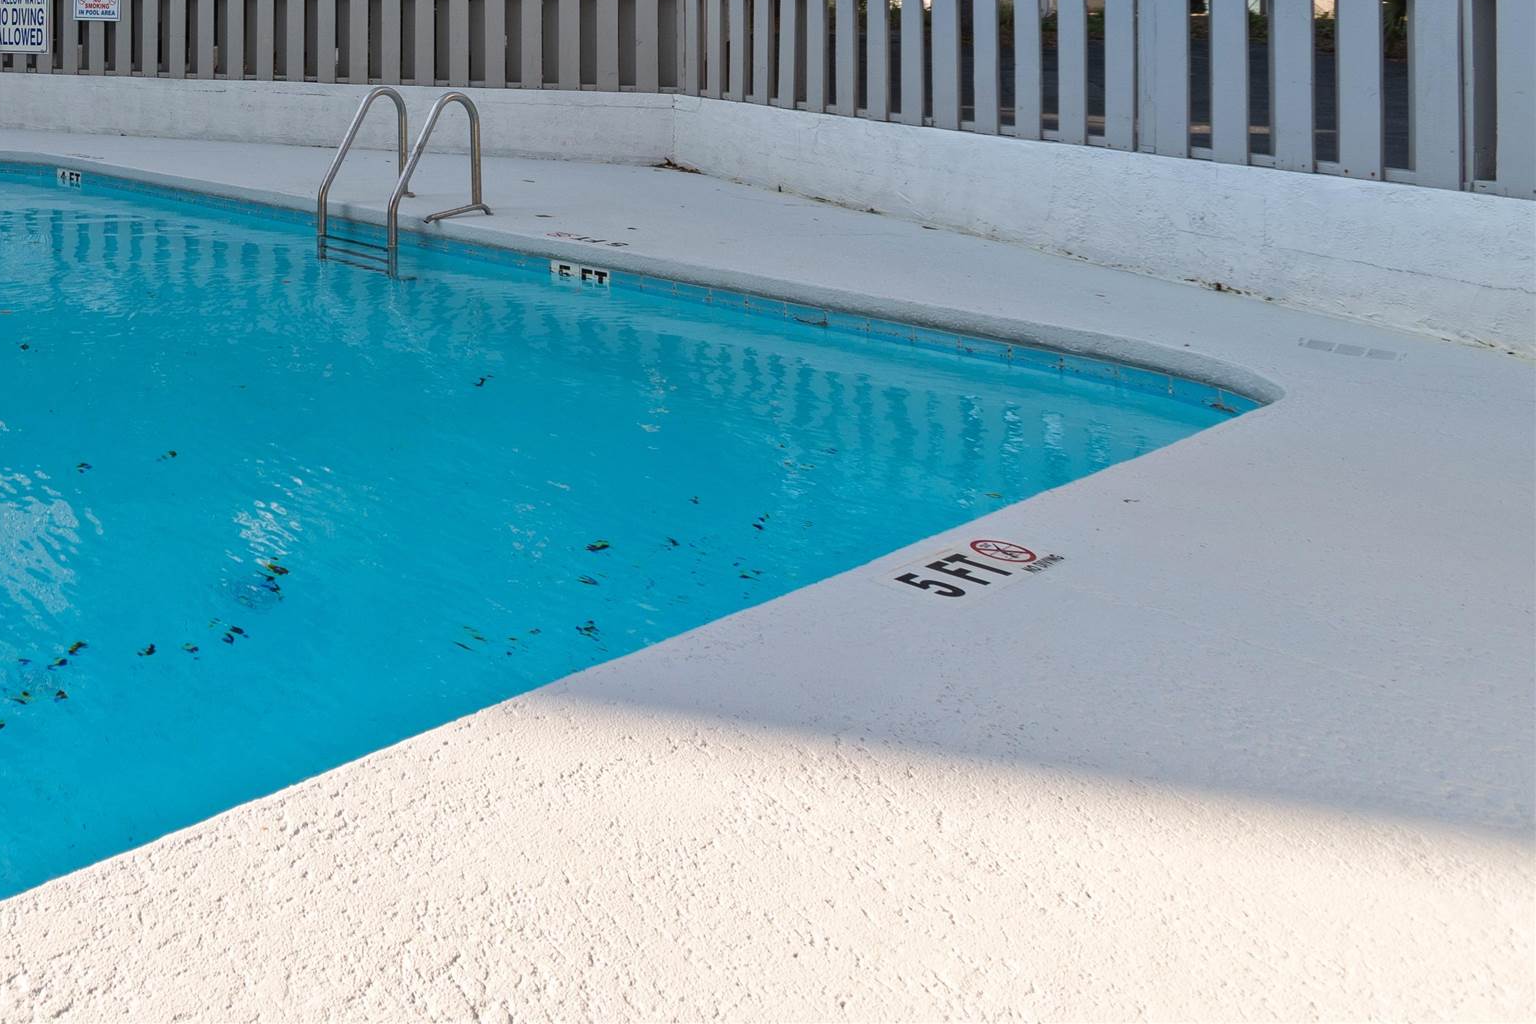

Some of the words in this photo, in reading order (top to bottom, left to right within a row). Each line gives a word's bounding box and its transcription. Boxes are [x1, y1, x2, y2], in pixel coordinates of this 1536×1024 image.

[11, 7, 44, 25] DIVING
[581, 268, 608, 284] FT
[925, 553, 1013, 586] FT
[894, 572, 966, 597] 5
